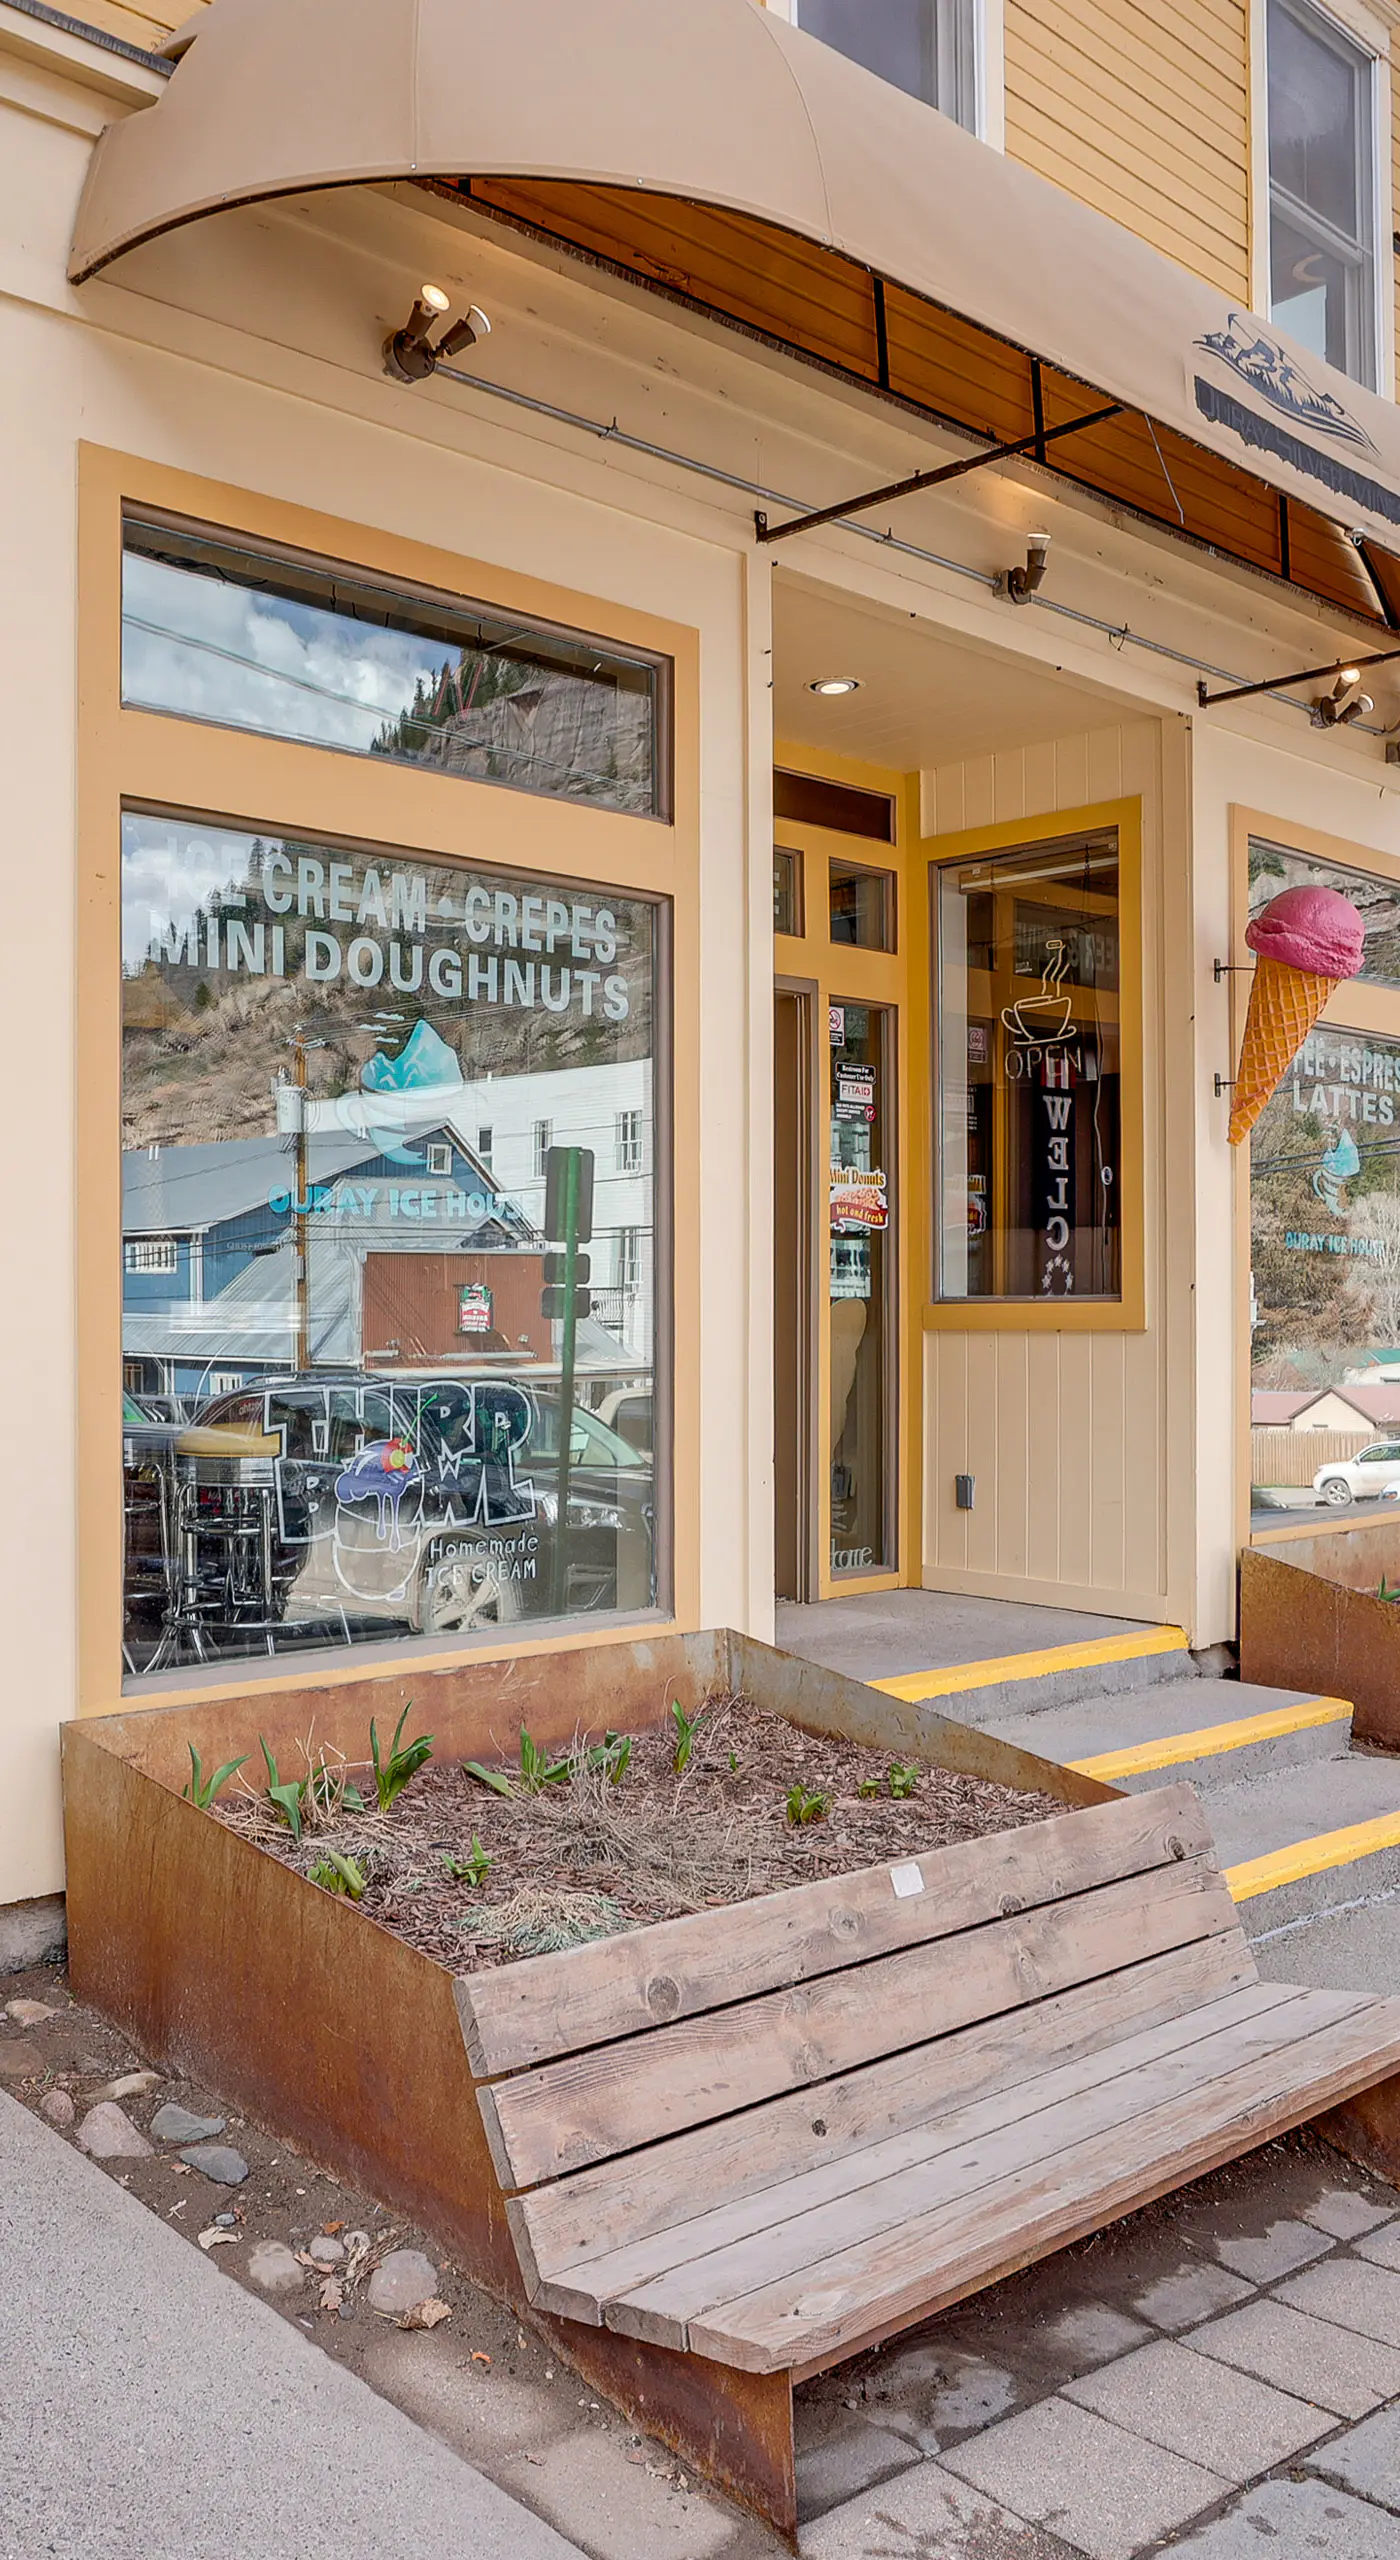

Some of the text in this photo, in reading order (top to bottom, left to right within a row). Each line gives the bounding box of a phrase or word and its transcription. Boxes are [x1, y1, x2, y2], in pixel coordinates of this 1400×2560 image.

[167, 836, 617, 964] ICE CREAM CREPES
[149, 910, 630, 1021] MINI DOUGHNUTS
[1004, 1044, 1082, 1080] OPEN
[841, 1084, 871, 1097] FITAID
[1293, 1079, 1395, 1126] LATTES
[830, 1168, 885, 1186] Mini Donuts
[388, 1188, 438, 1219] ICE
[836, 1205, 884, 1224] hot and fresh
[1286, 1231, 1326, 1251] OURAY
[1328, 1234, 1348, 1254] ICE
[429, 1531, 539, 1559] Homemade
[425, 1558, 537, 1589] ICE CREAM
